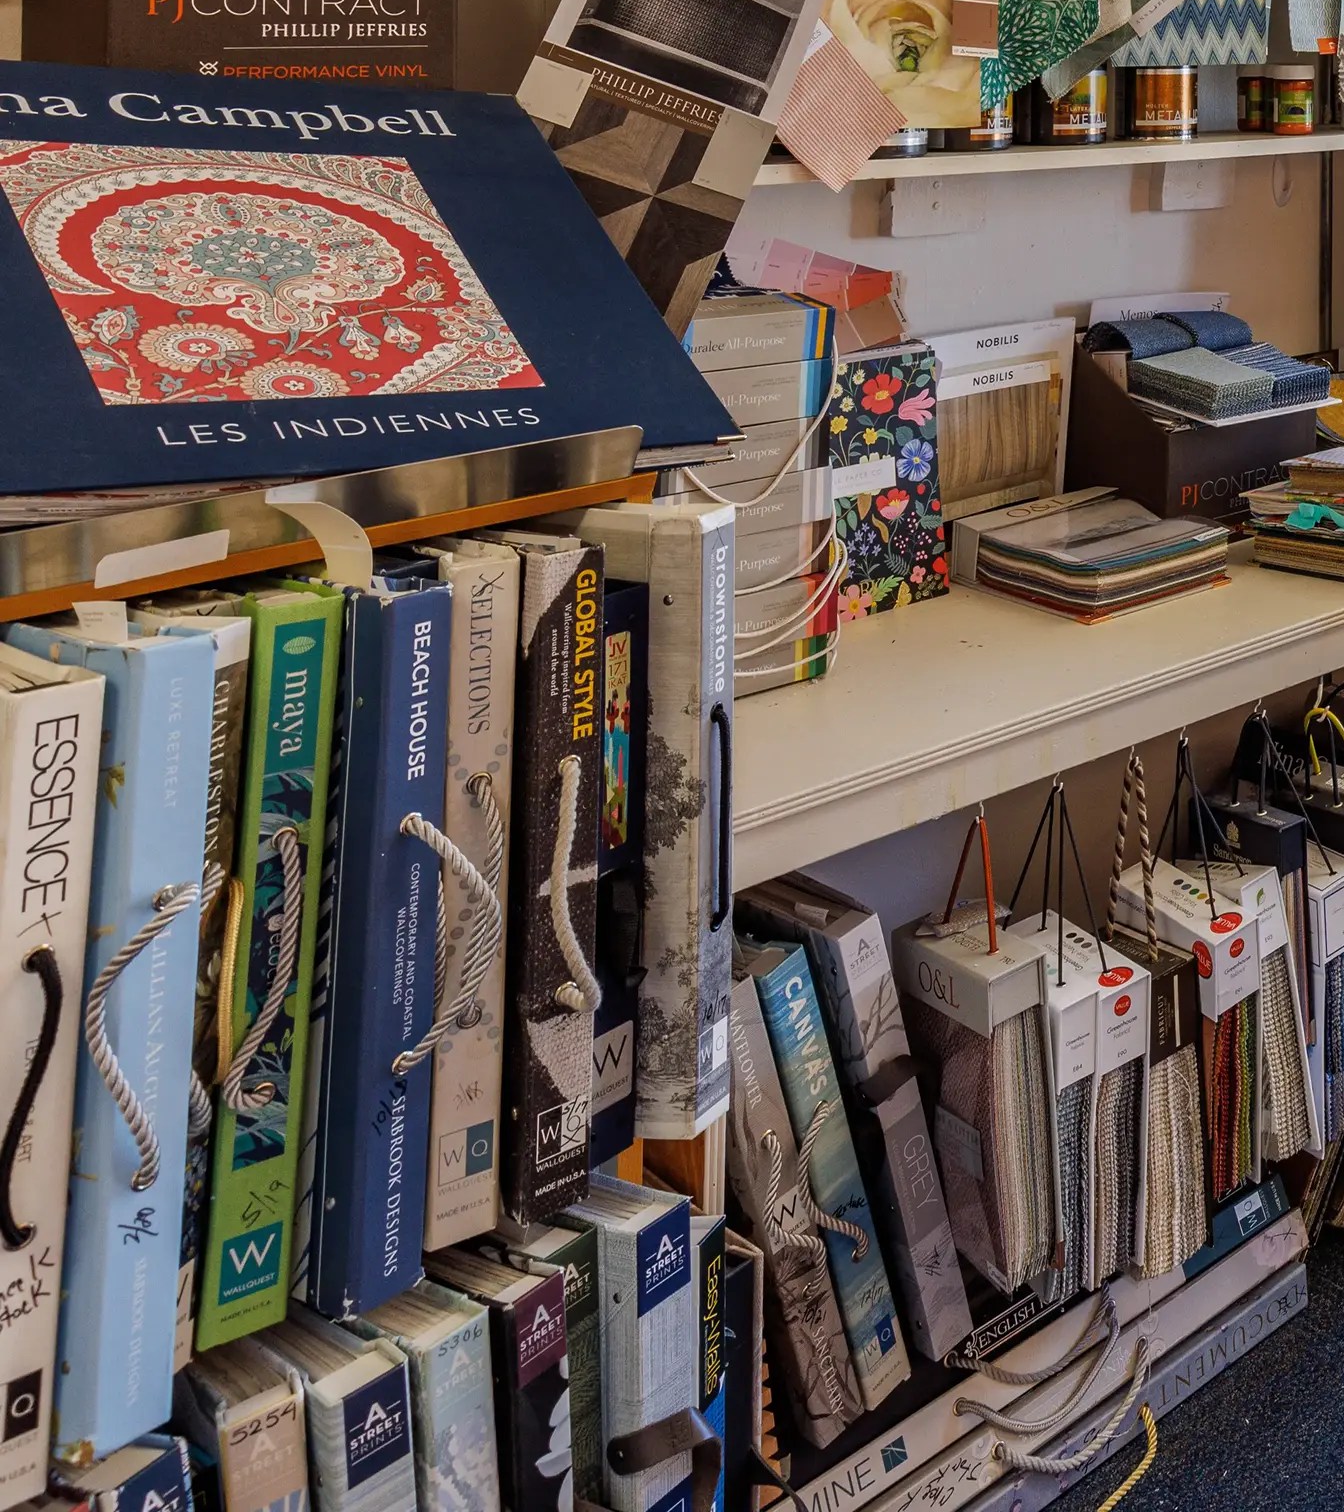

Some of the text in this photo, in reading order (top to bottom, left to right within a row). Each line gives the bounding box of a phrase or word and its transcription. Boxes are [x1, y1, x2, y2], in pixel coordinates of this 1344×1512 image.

[262, 23, 427, 40] PHILLIP JEFFRIES
[224, 65, 428, 78] PERFORMANCE VINYL
[591, 67, 655, 99] PHILLIP
[107, 92, 457, 139] Campbell
[976, 334, 1019, 349] NOBILIS
[972, 371, 1014, 387] NOBILIS
[157, 407, 541, 446] LES INDIENNES
[563, 603, 574, 665] Wallcoverings
[714, 546, 728, 693] brownstone
[572, 569, 596, 740] GLOBAL STYLE
[407, 620, 432, 780] BEACH HOUSE
[562, 666, 570, 692] inspired
[271, 668, 309, 757] maya
[203, 679, 230, 853] CHARLESTON
[21, 713, 79, 914] ESSENCE
[393, 908, 407, 1004] WALLCOVERINGS
[401, 863, 421, 1040] CONTEMPORARY AND COASTAL
[1224, 955, 1251, 975] Greenhouse
[918, 961, 959, 1009] O&L
[783, 979, 830, 1096] CANVAS
[1066, 1032, 1090, 1047] Greenhouse
[1107, 1015, 1138, 1034] Greenhouse
[727, 1008, 762, 1111] MAYFLOWER
[536, 1145, 585, 1173] WALLQUEST
[902, 1132, 942, 1209] GREY
[383, 1095, 406, 1277] SEABROOK DESIGNS
[535, 1183, 557, 1197] MADE
[645, 1246, 684, 1280] STREET
[645, 1256, 685, 1290] PRINTS
[223, 1272, 275, 1298] WALLQUEST
[519, 1316, 562, 1350] STREET
[519, 1328, 562, 1362] PRINTS
[703, 1254, 722, 1396] Easy-Walls
[978, 1302, 1036, 1349] ENGLISH
[810, 1324, 845, 1417] SANCTUARY
[1158, 1290, 1300, 1411] DOCUMENT
[350, 1413, 402, 1450] STREET
[350, 1426, 402, 1464] PRINTS
